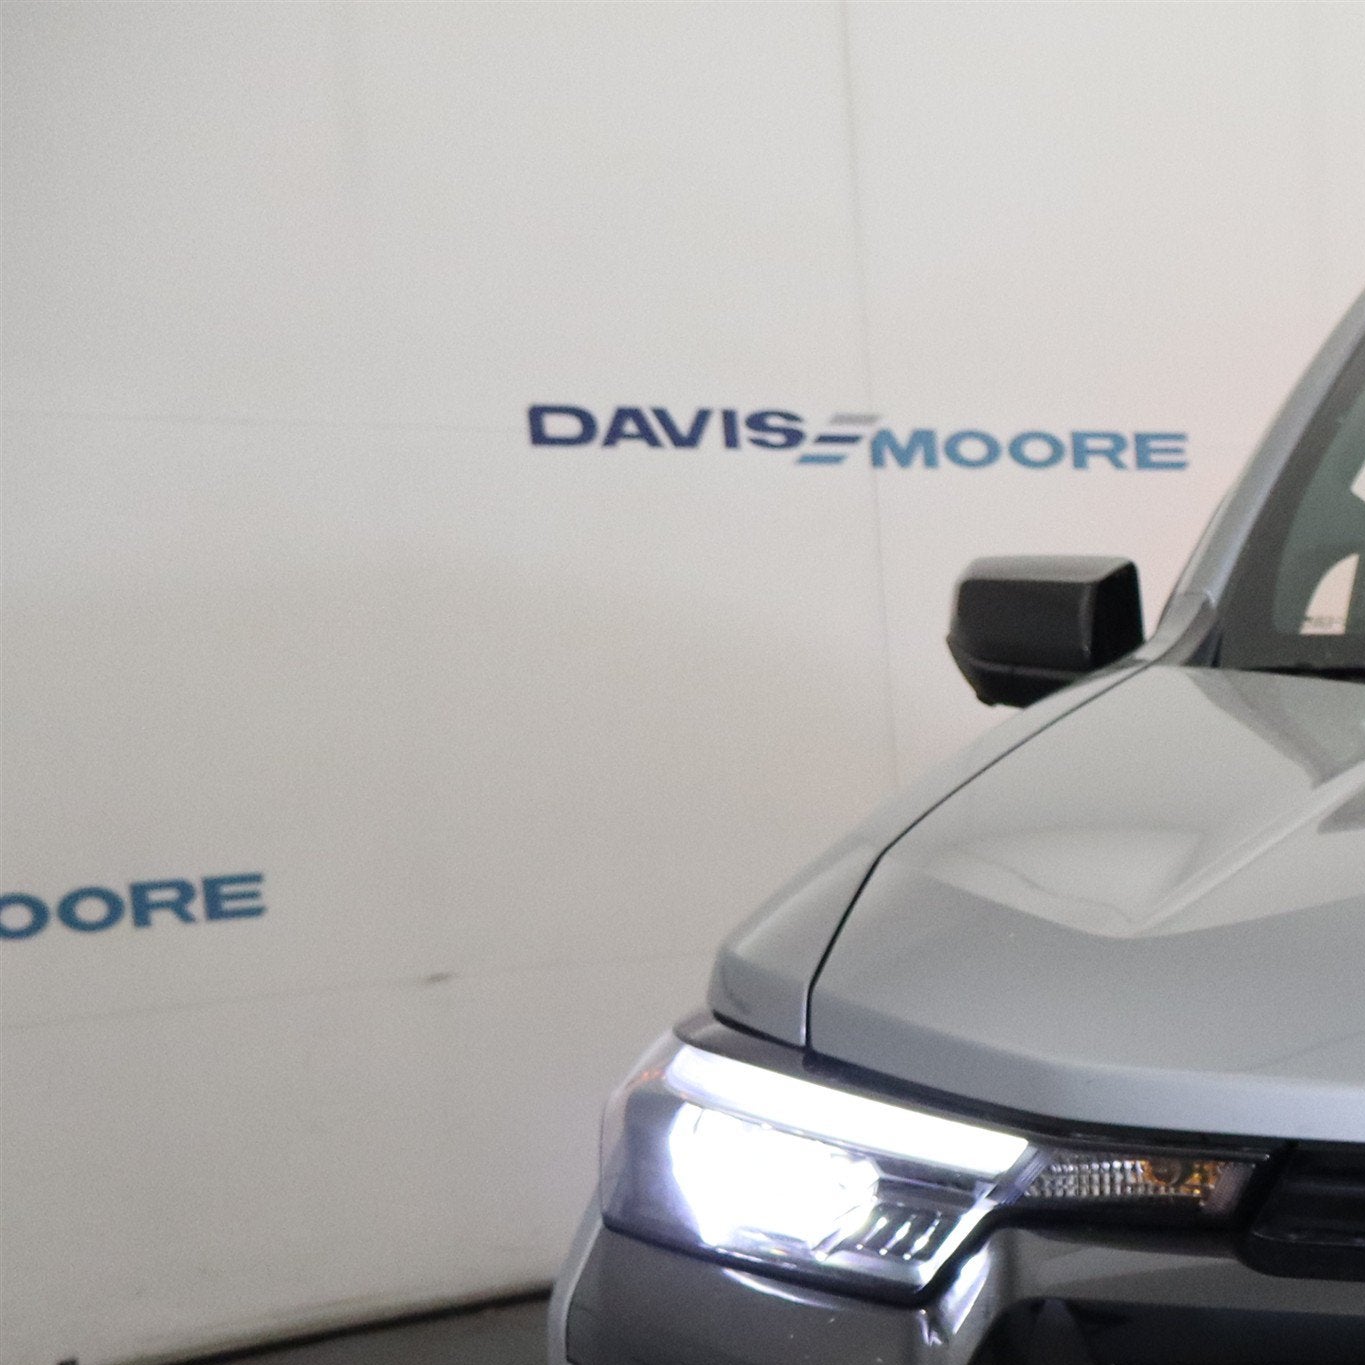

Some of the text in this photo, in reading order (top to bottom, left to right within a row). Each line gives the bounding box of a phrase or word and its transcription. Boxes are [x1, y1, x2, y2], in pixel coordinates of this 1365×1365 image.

[528, 403, 1189, 470] DAVIS MOORE
[0, 872, 266, 940] OORE
